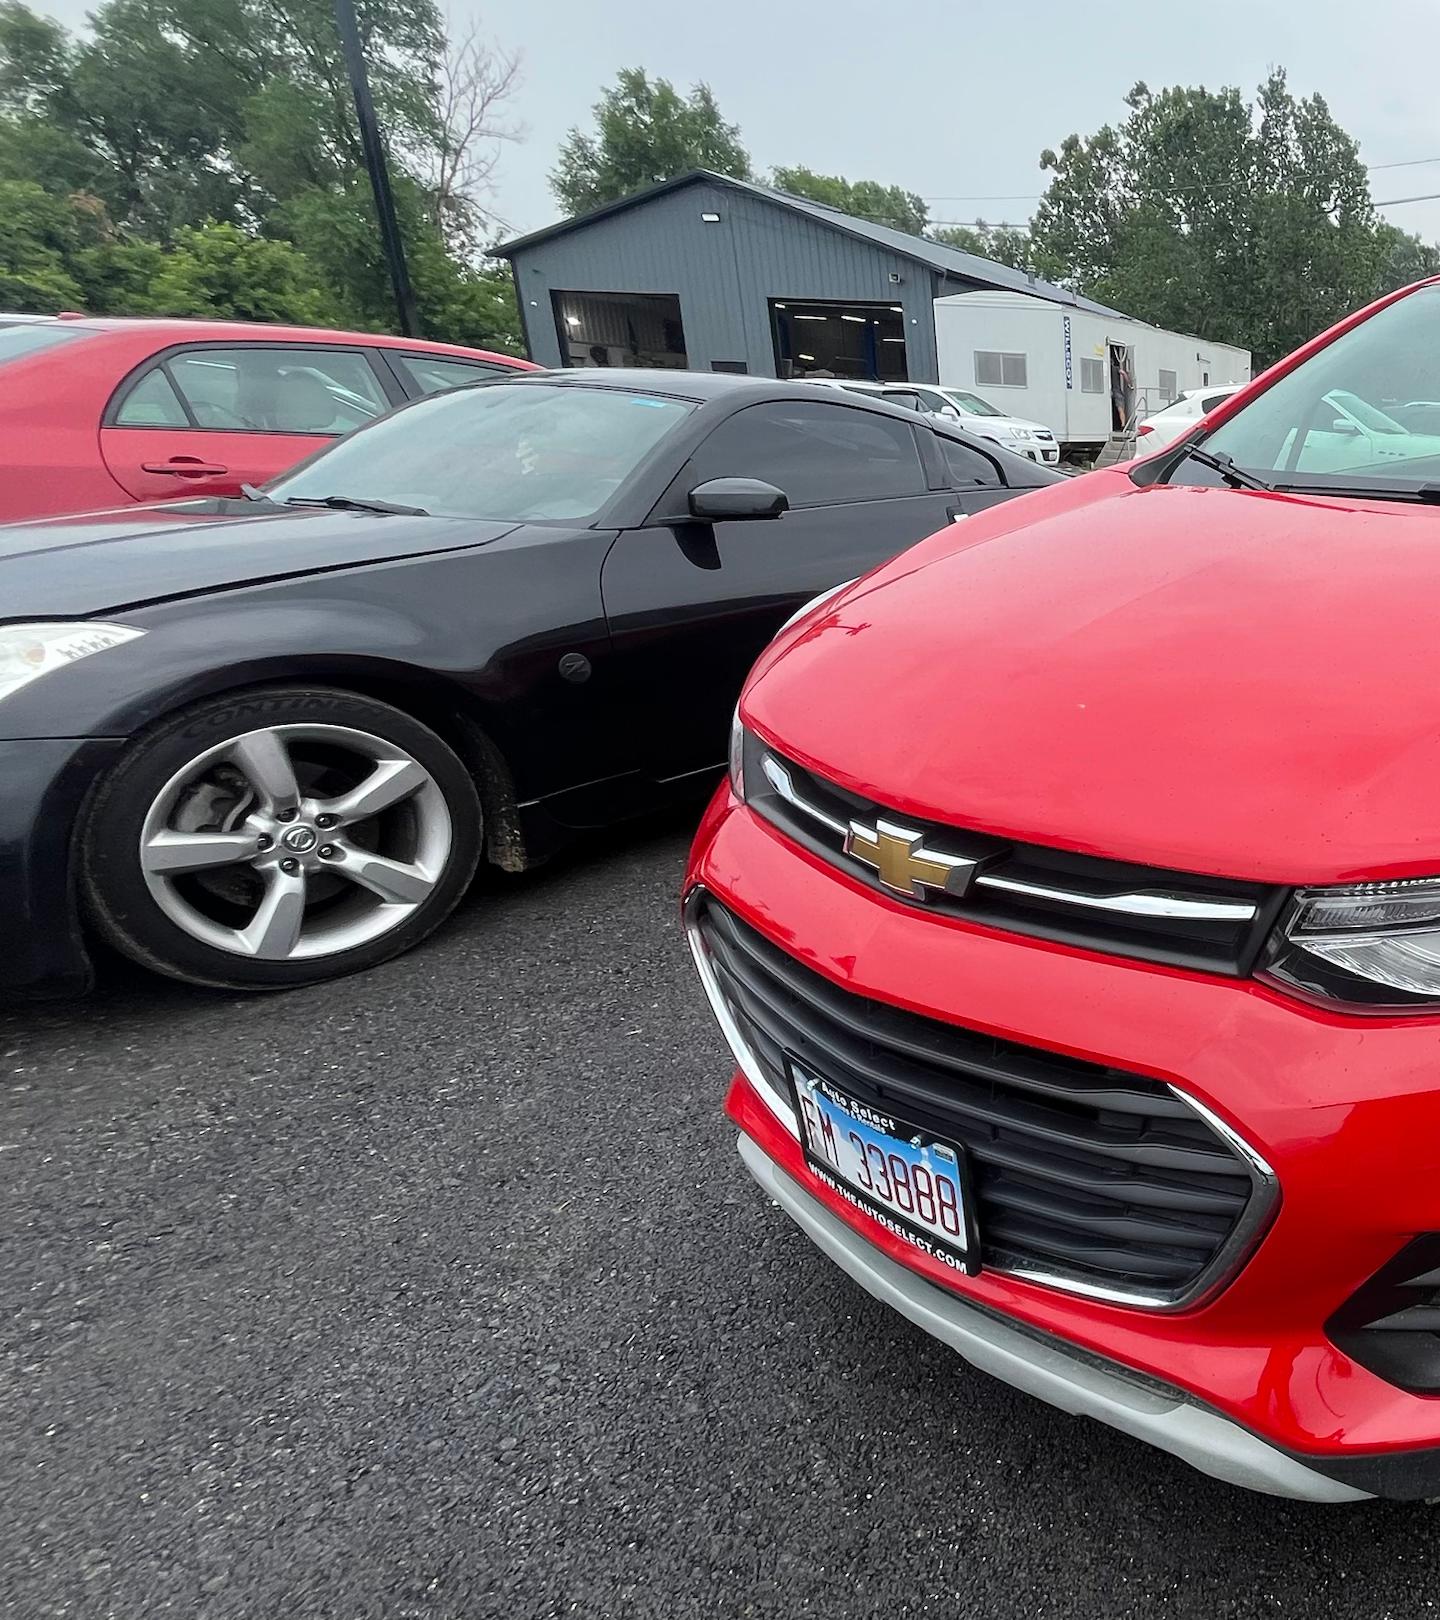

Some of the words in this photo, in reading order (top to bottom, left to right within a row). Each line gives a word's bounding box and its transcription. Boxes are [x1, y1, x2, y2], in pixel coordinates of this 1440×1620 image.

[821, 1081, 848, 1107] Auto
[850, 1100, 896, 1131] Select
[800, 1094, 840, 1168] FM
[849, 1130, 960, 1236] 33888
[808, 1161, 968, 1275] WWW.THEAUTOSELECT.COM
